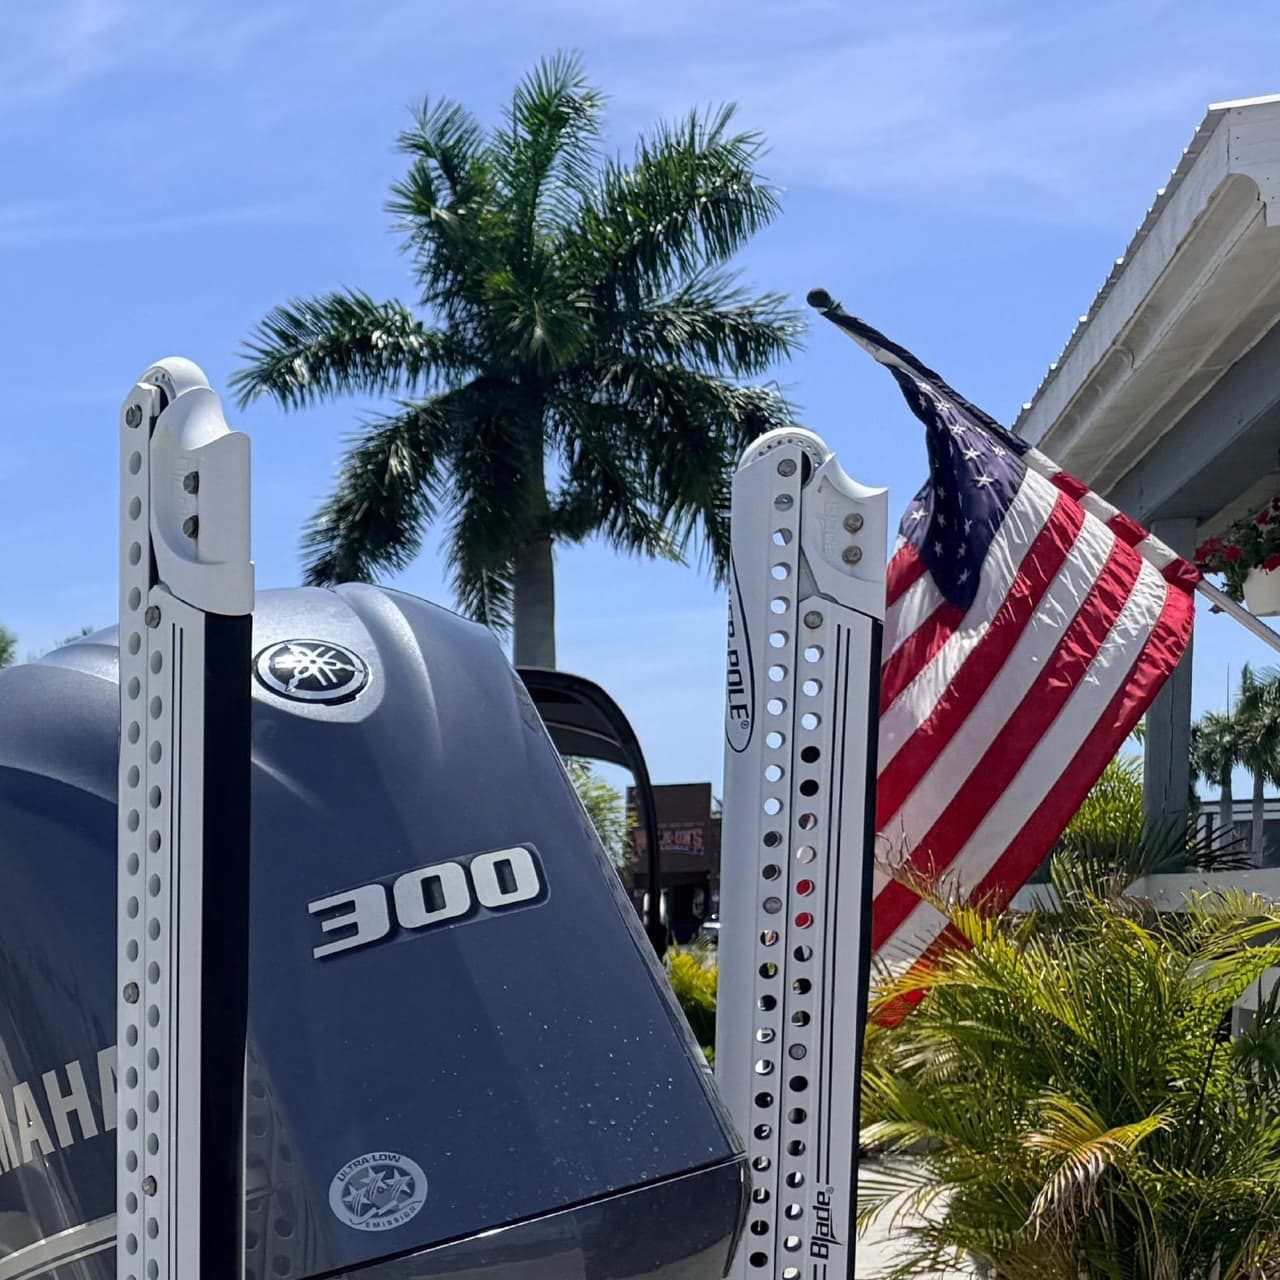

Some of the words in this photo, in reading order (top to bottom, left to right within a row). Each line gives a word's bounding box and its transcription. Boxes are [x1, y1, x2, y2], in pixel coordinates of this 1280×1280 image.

[308, 847, 541, 960] 300
[365, 1205, 417, 1229] EMISSION
[810, 1190, 842, 1260] Blade
